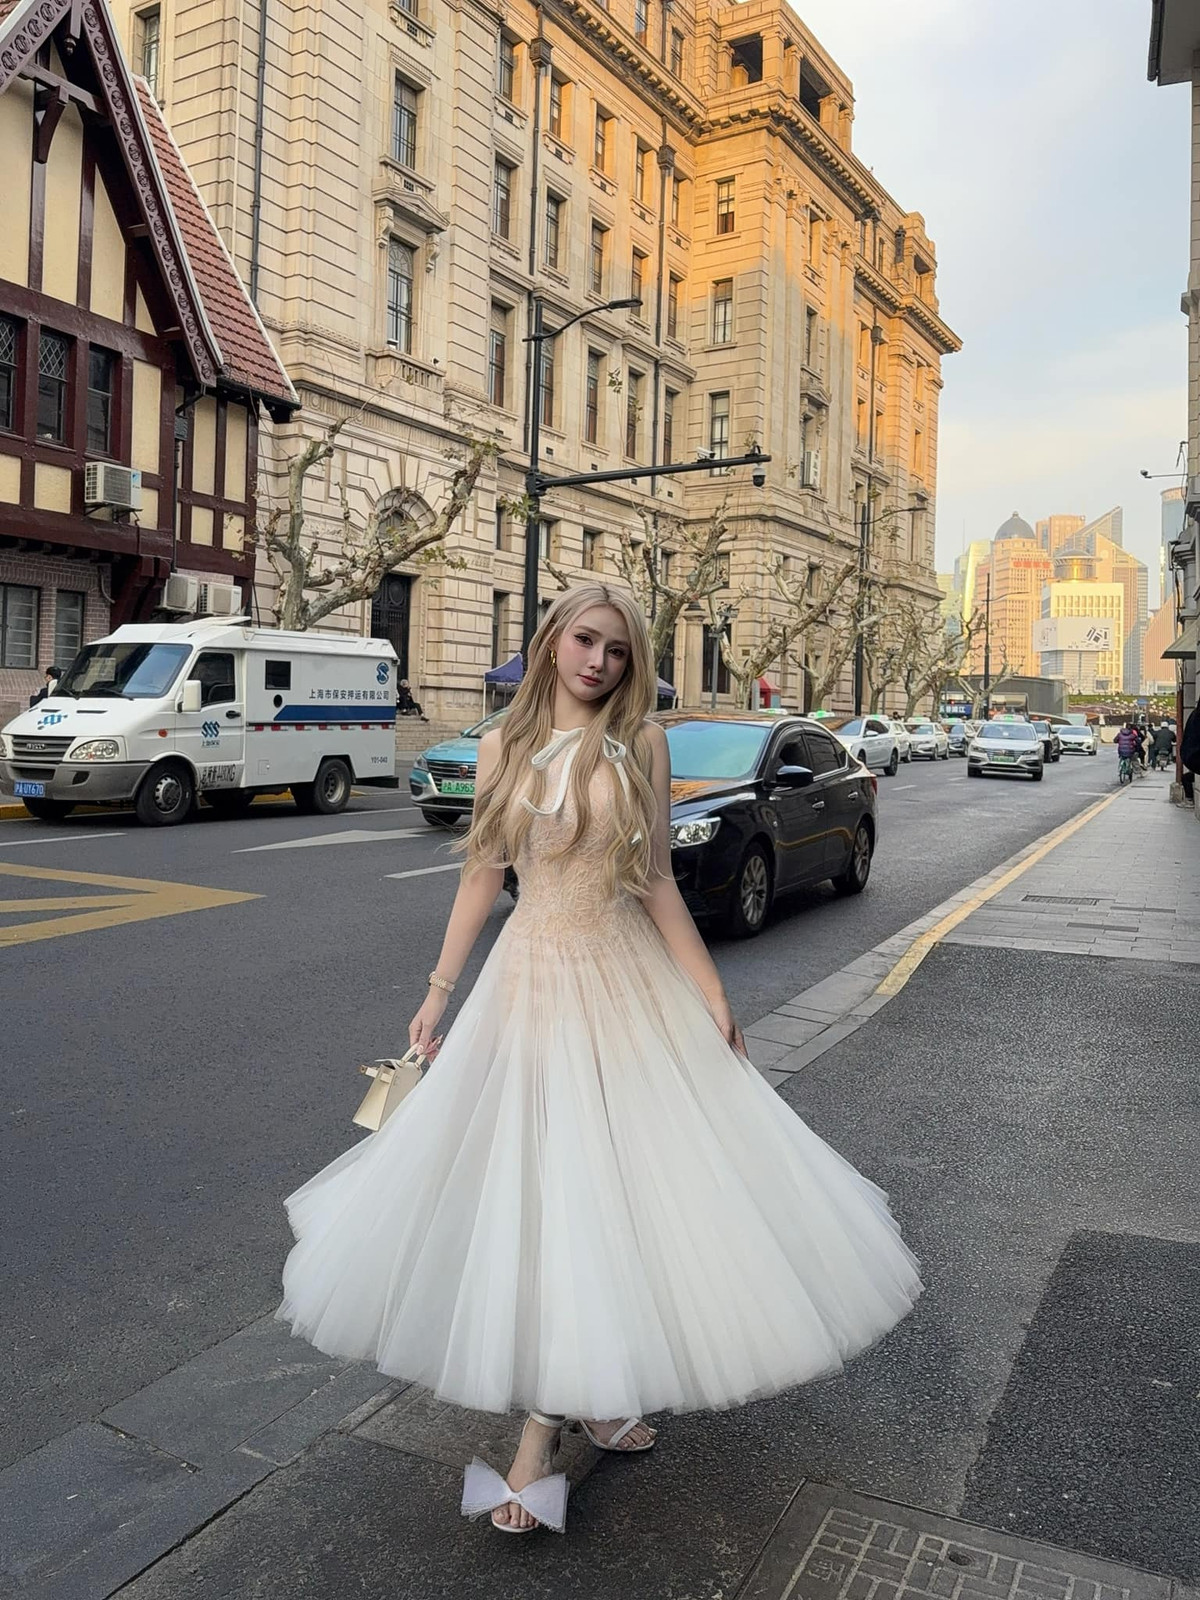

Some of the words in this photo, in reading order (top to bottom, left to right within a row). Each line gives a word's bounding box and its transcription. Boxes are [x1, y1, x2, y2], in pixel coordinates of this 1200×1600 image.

[309, 688, 389, 701] 上海市保安押运有限公司
